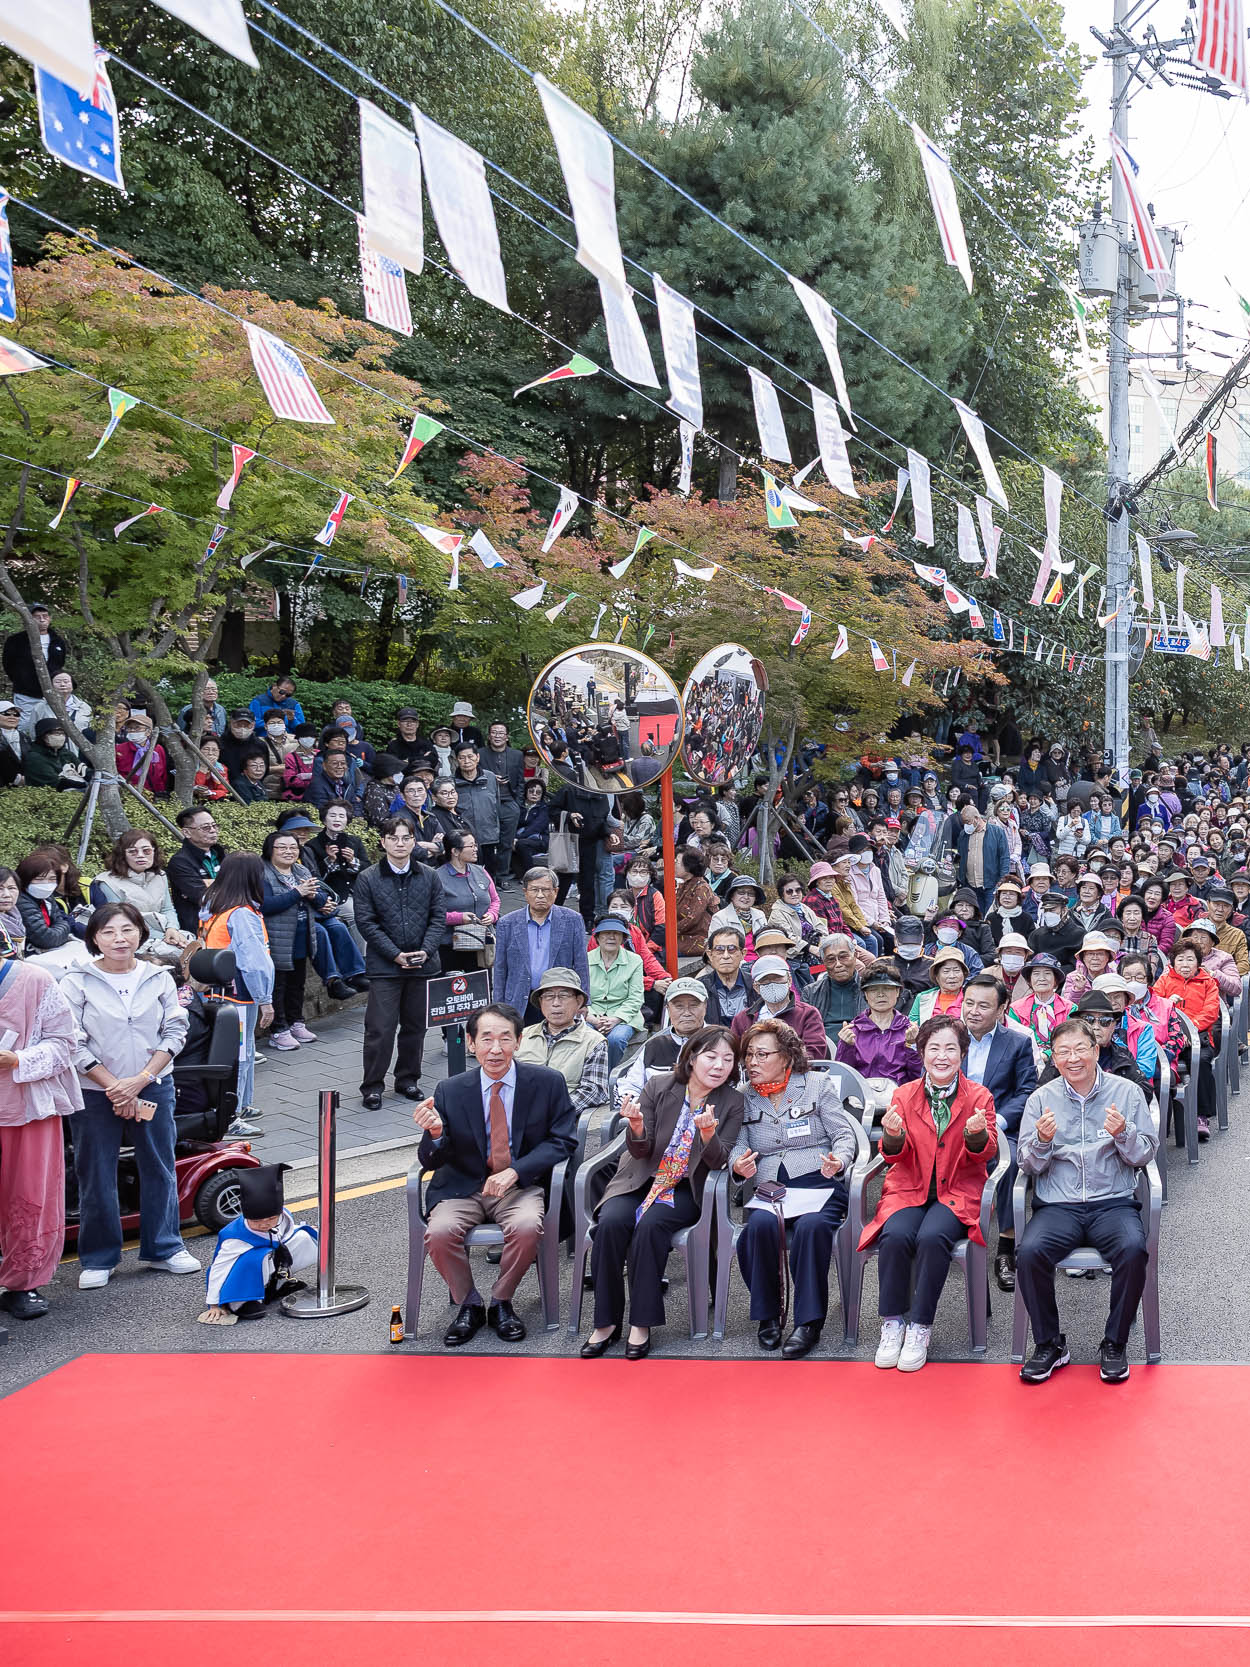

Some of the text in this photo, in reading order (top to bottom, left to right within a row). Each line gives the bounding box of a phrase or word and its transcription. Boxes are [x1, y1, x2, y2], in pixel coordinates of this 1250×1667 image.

[446, 993, 474, 1005] 오토바이
[430, 1006, 446, 1016] 진입
[447, 1005, 455, 1014] 및
[456, 1002, 470, 1011] 주차
